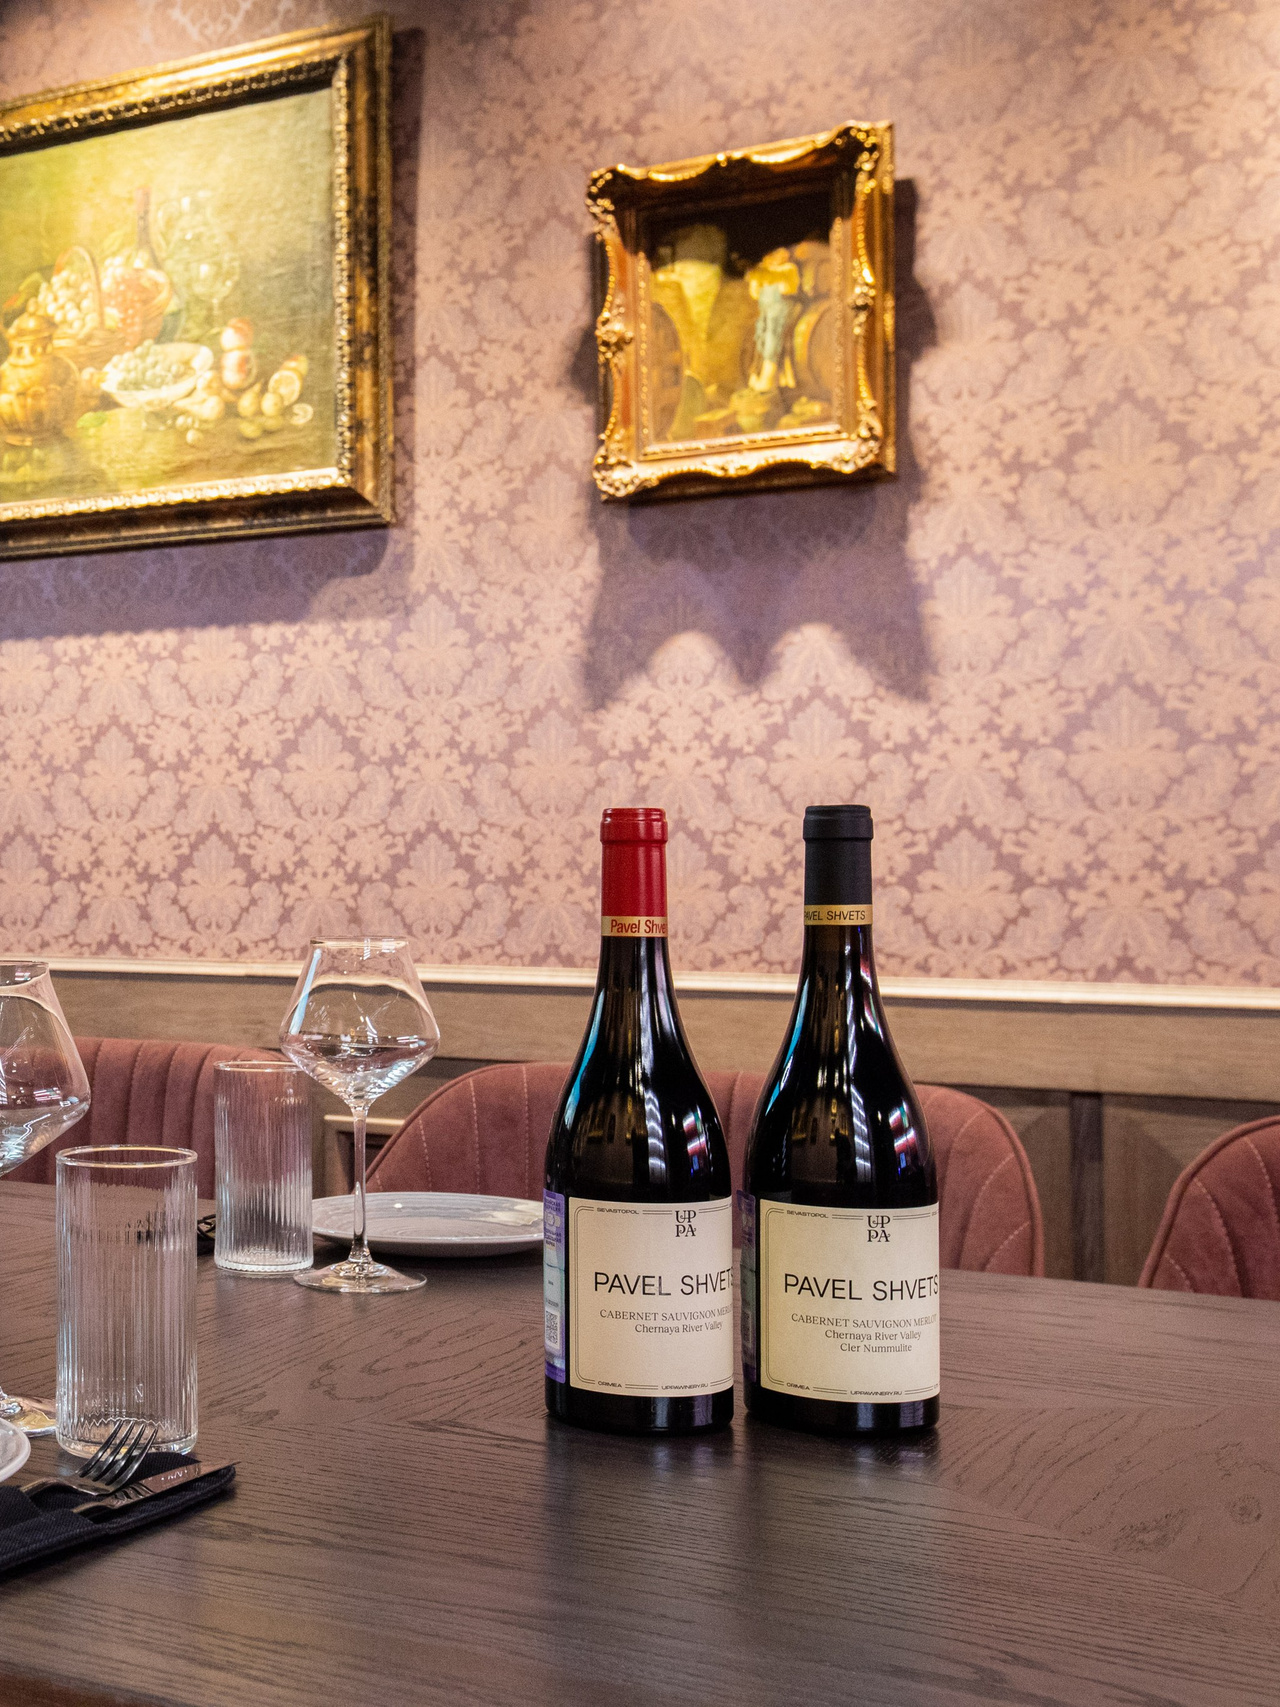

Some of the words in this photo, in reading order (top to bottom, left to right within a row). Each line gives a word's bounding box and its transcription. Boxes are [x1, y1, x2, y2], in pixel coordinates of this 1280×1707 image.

[826, 910, 866, 921] SHVETS
[610, 918, 641, 934] Pavel
[644, 919, 667, 934] Shve
[596, 1207, 640, 1215] SEVASTOPOL
[675, 1209, 697, 1224] UP
[786, 1209, 829, 1219] SEVASTOPOL
[866, 1215, 891, 1229] UP
[675, 1224, 697, 1237] PA
[866, 1229, 891, 1243] PA
[594, 1271, 671, 1296] PAVEL
[784, 1273, 863, 1301] PAVEL
[872, 1274, 939, 1301] SHVETS
[599, 1309, 659, 1322] CABERNET
[661, 1309, 716, 1322] SAUVIGNON
[791, 1313, 850, 1328] CABERNET
[852, 1317, 912, 1329] SAUVIGNON
[913, 1313, 937, 1327] MERLOT
[634, 1323, 680, 1335] Chernaya
[682, 1322, 703, 1333] River
[704, 1320, 724, 1331] Valley
[824, 1329, 872, 1342] Chernaya
[874, 1331, 898, 1341] River
[900, 1329, 922, 1341] Valley
[839, 1342, 860, 1352] Cler
[863, 1342, 913, 1353] Nummulite
[597, 1380, 623, 1388] CRIMEA
[786, 1382, 811, 1391] CRIMEA
